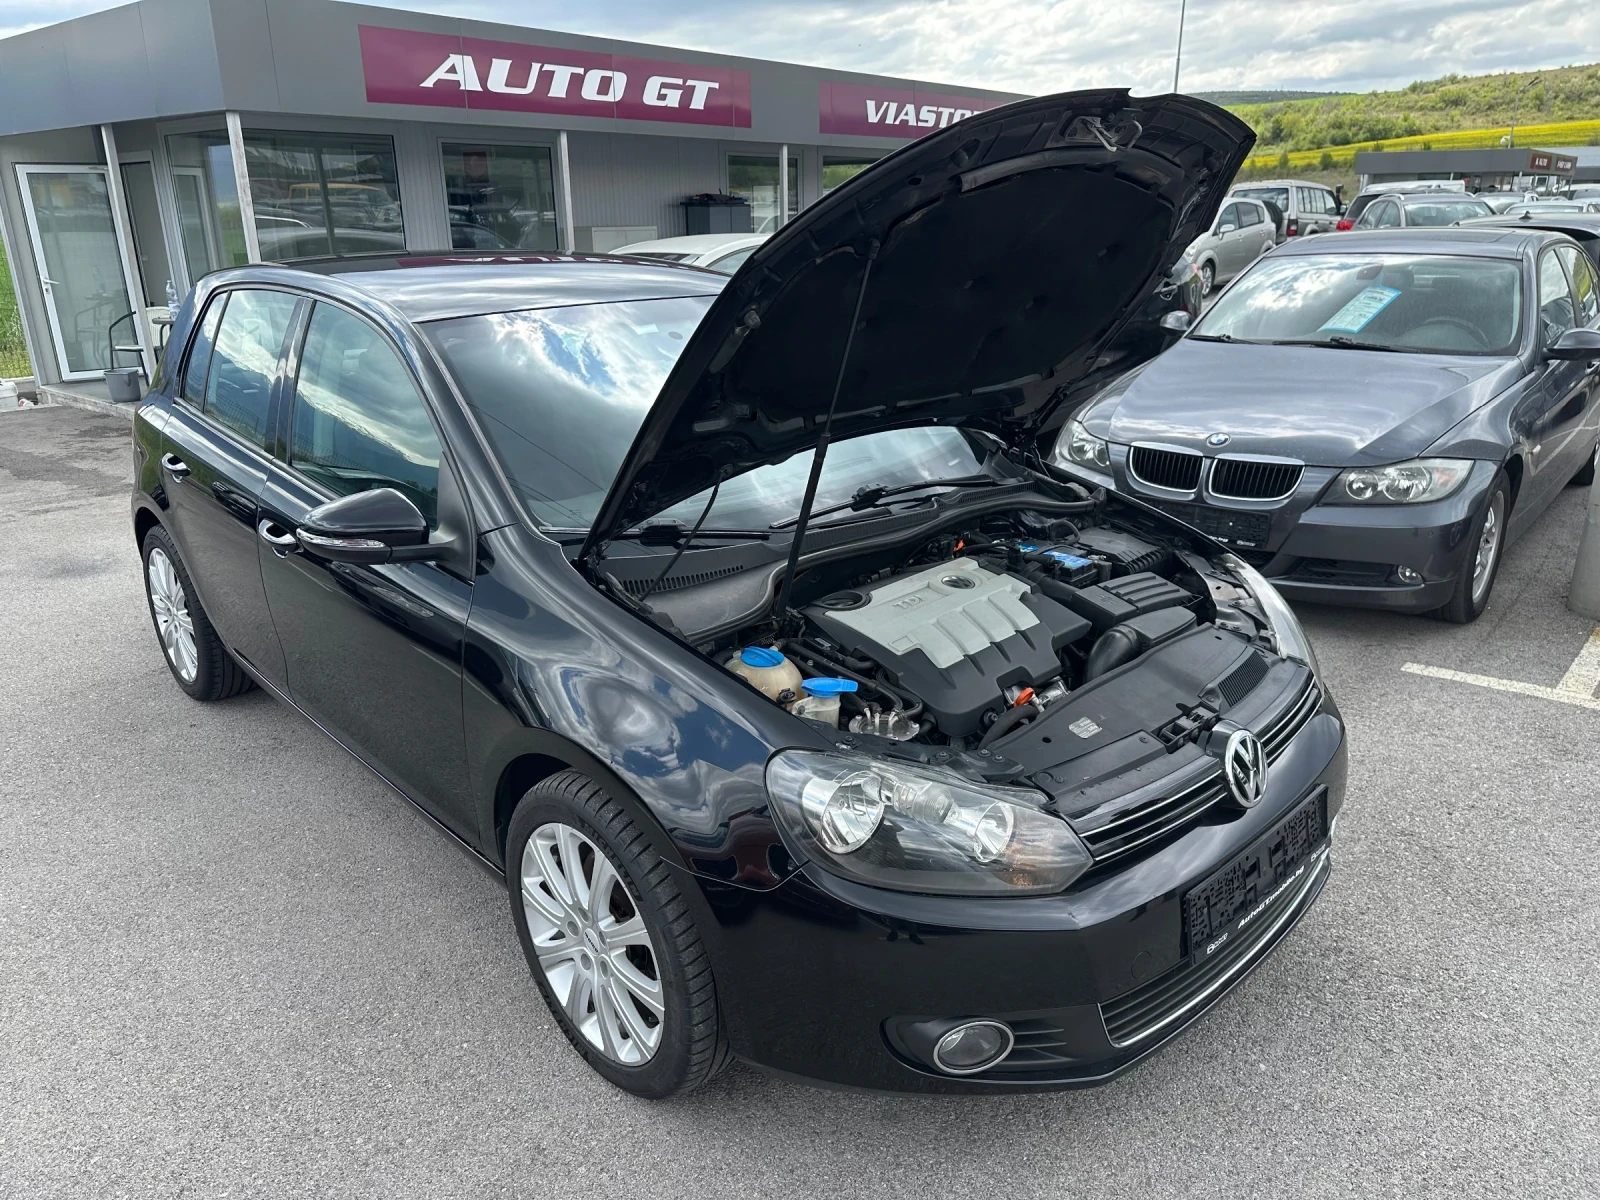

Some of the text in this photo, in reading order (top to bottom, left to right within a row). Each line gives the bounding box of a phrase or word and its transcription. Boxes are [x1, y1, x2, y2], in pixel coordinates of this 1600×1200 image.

[420, 53, 719, 111] AUTO GT
[892, 595, 928, 610] TDI
[582, 821, 641, 898] MICHELIN
